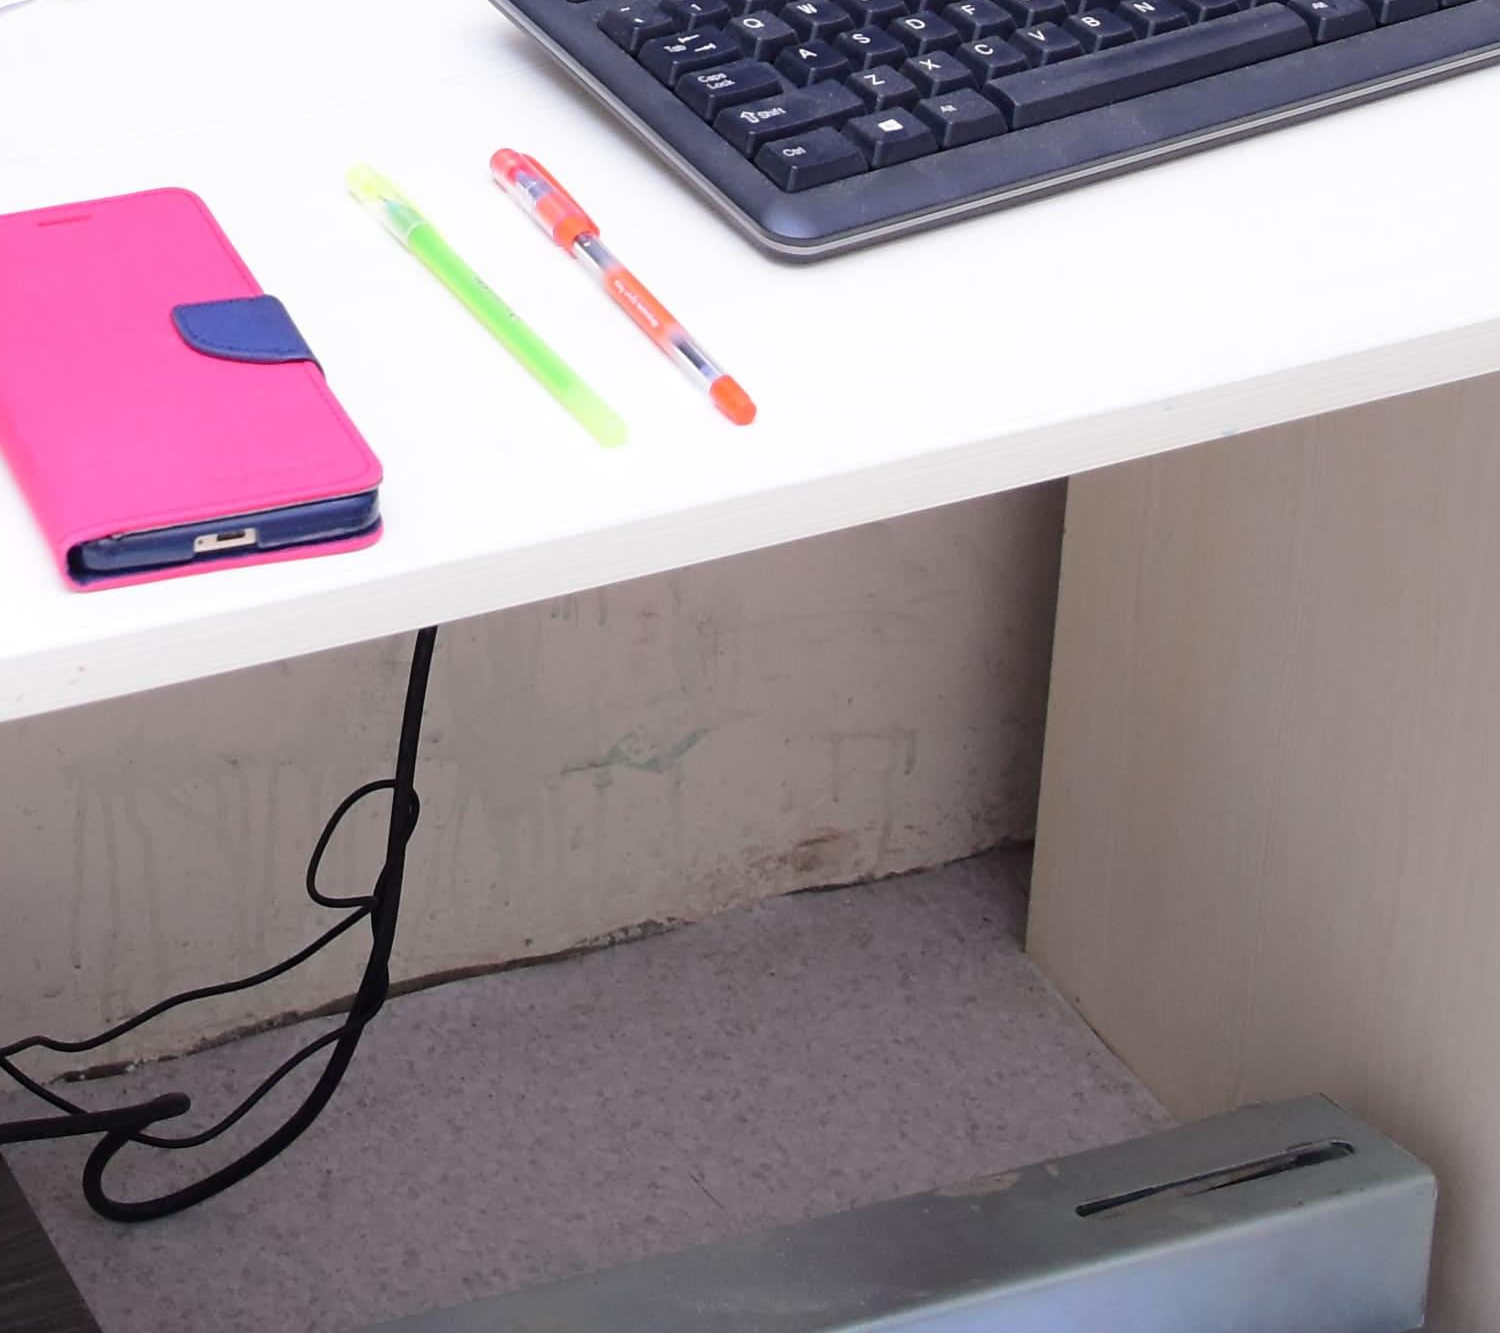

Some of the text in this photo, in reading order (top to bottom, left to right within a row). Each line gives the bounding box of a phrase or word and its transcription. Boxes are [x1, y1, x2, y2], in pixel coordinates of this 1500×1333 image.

[797, 1, 819, 15] W
[960, 3, 977, 17] F
[1133, 1, 1157, 14] N
[743, 17, 765, 29] Q
[904, 17, 927, 30] D
[1080, 15, 1102, 29] B
[851, 32, 873, 45] S
[1027, 29, 1047, 43] V
[798, 47, 818, 61] A
[973, 43, 995, 56] C
[918, 58, 943, 71] X
[697, 71, 728, 85] Caps
[706, 78, 736, 90] Lock
[863, 73, 886, 87] Z
[782, 145, 806, 158] Ctrl
